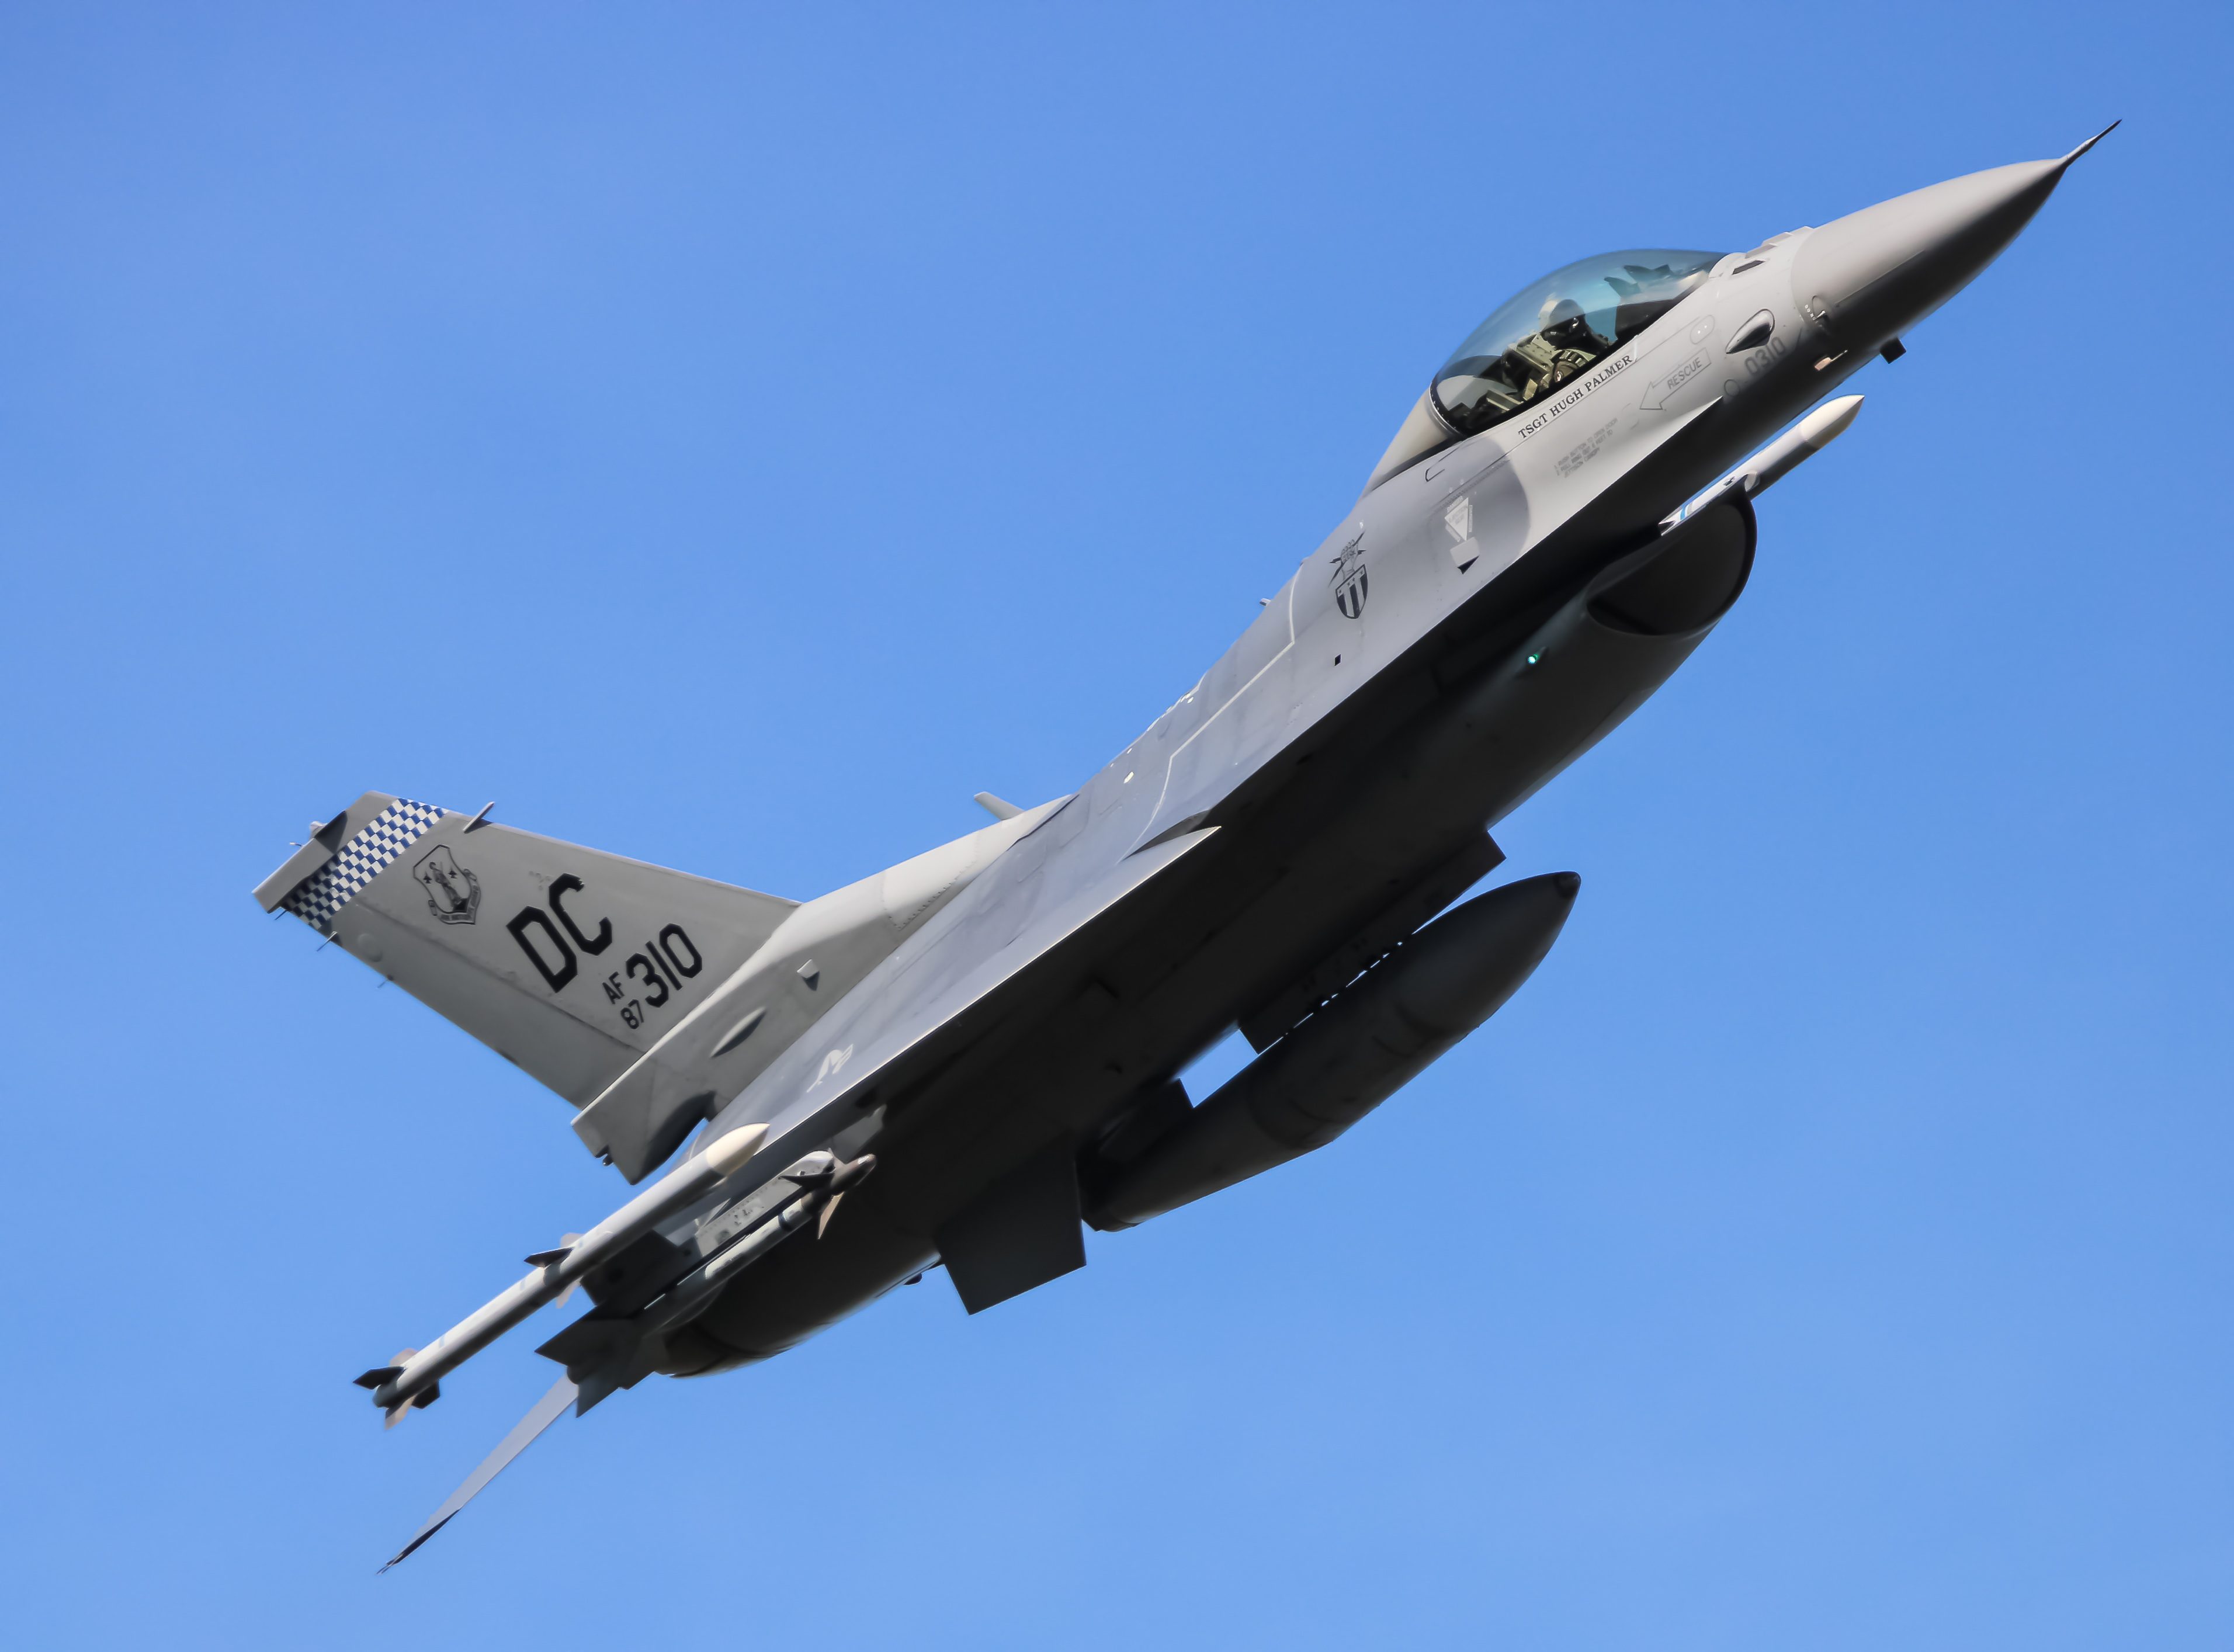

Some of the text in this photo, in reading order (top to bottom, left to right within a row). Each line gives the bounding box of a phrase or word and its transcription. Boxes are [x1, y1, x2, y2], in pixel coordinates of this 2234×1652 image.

[1667, 357, 1702, 390] RESCUE
[1744, 336, 1786, 376] 0310
[1518, 355, 1633, 439] TSGT HUGH PALMER
[506, 873, 612, 993] DC
[625, 923, 703, 1008] 310
[602, 971, 625, 1005] AF
[620, 999, 644, 1030] 87
